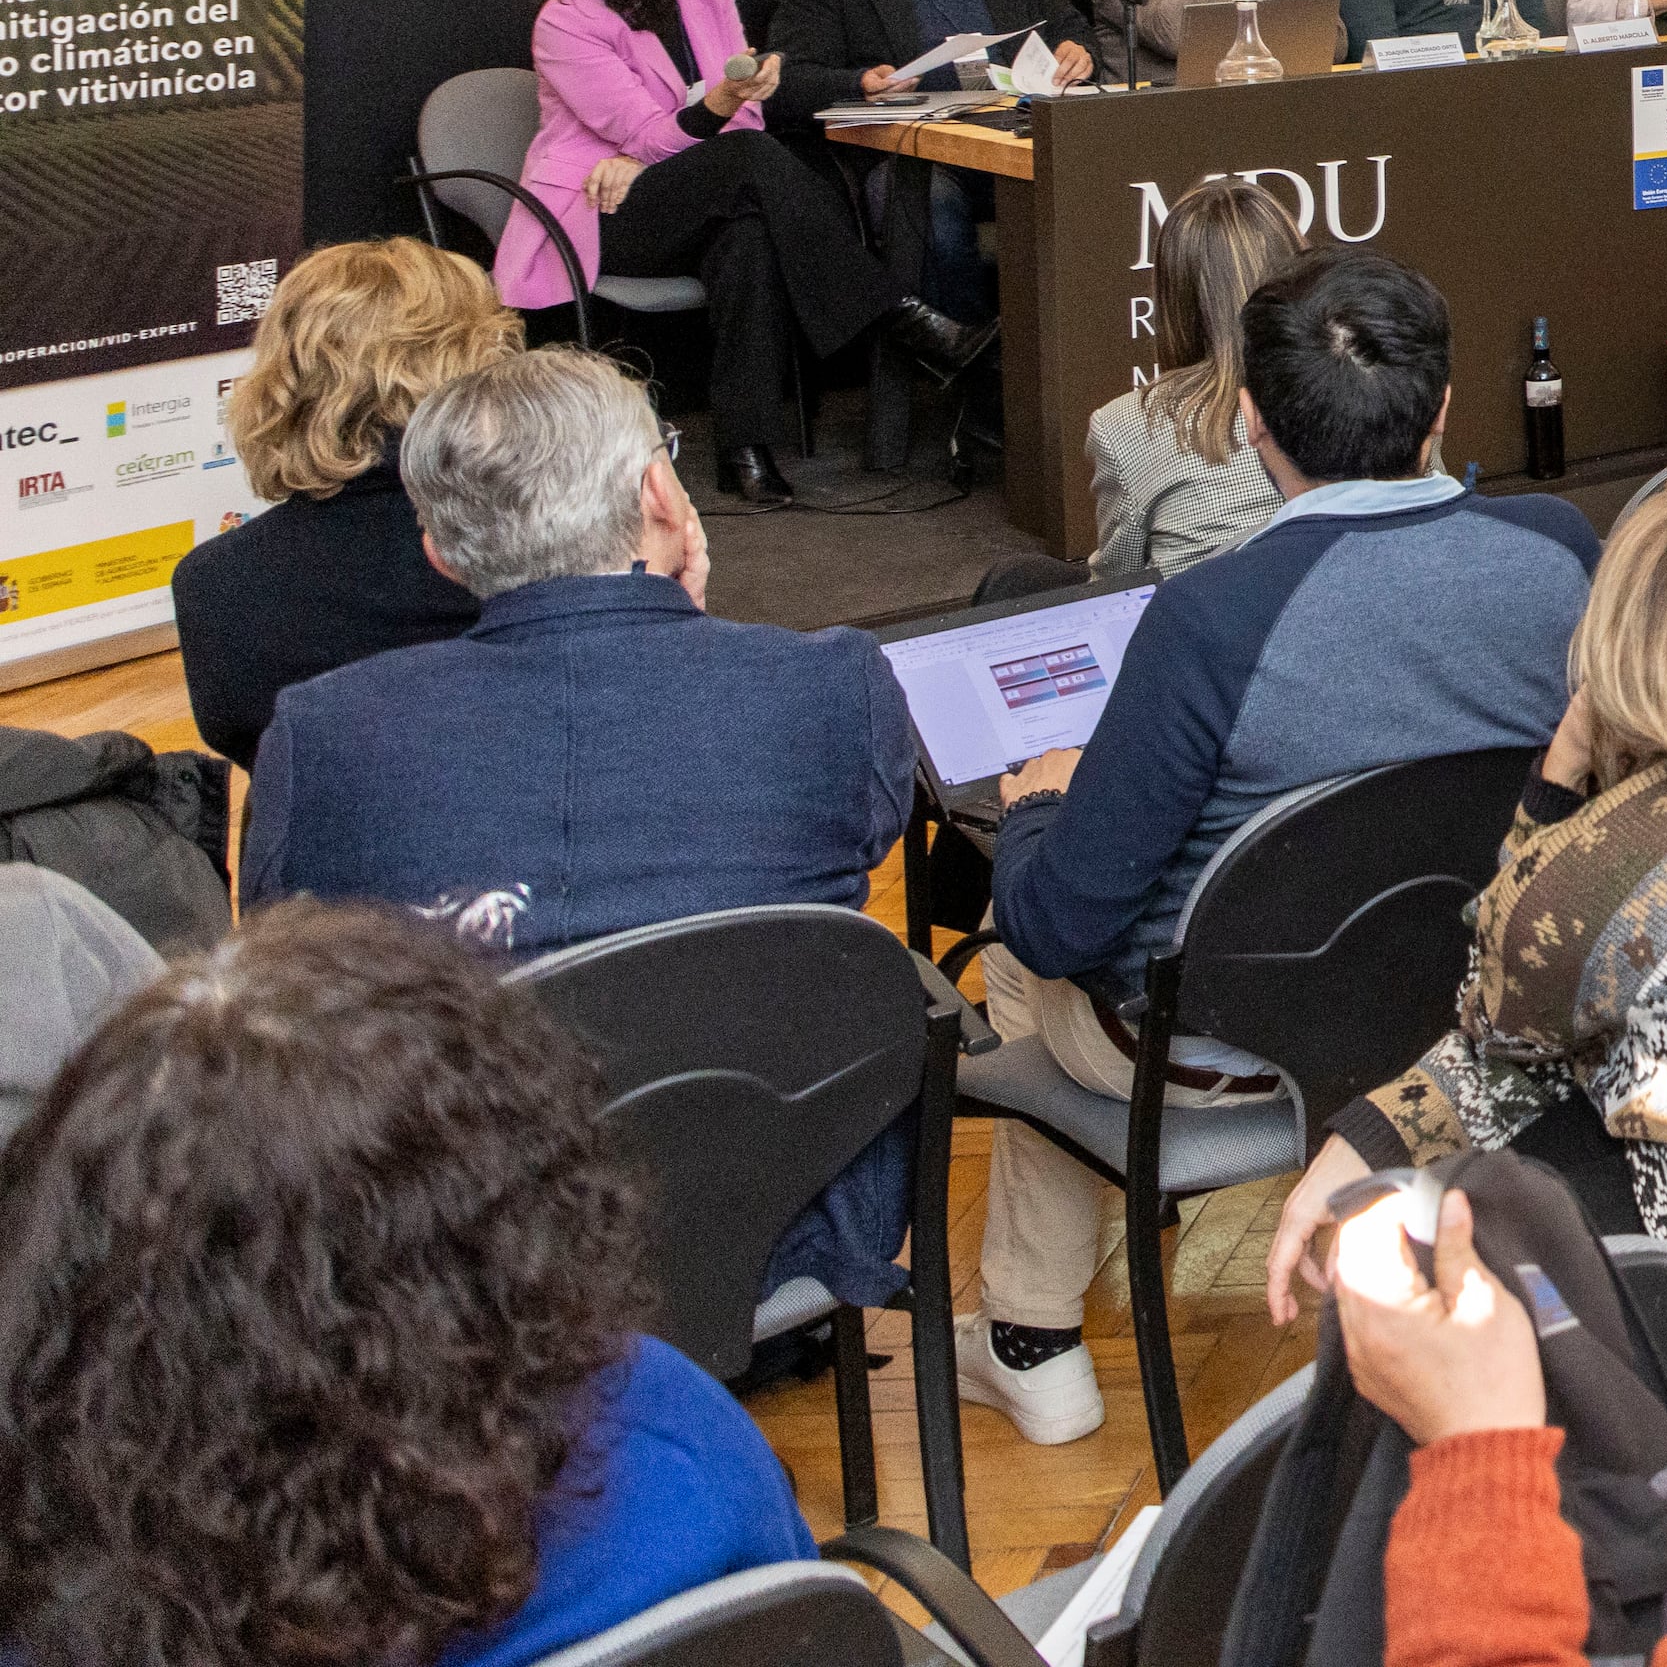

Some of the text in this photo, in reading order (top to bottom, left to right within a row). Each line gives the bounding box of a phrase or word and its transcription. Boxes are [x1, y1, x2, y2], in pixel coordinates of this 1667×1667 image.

[1591, 35, 1618, 43] ALBERTO
[30, 36, 203, 73] climático
[213, 34, 255, 57] en
[57, 63, 257, 107] vitivinícola
[131, 395, 191, 417] Intergia
[18, 471, 66, 498] IRTA
